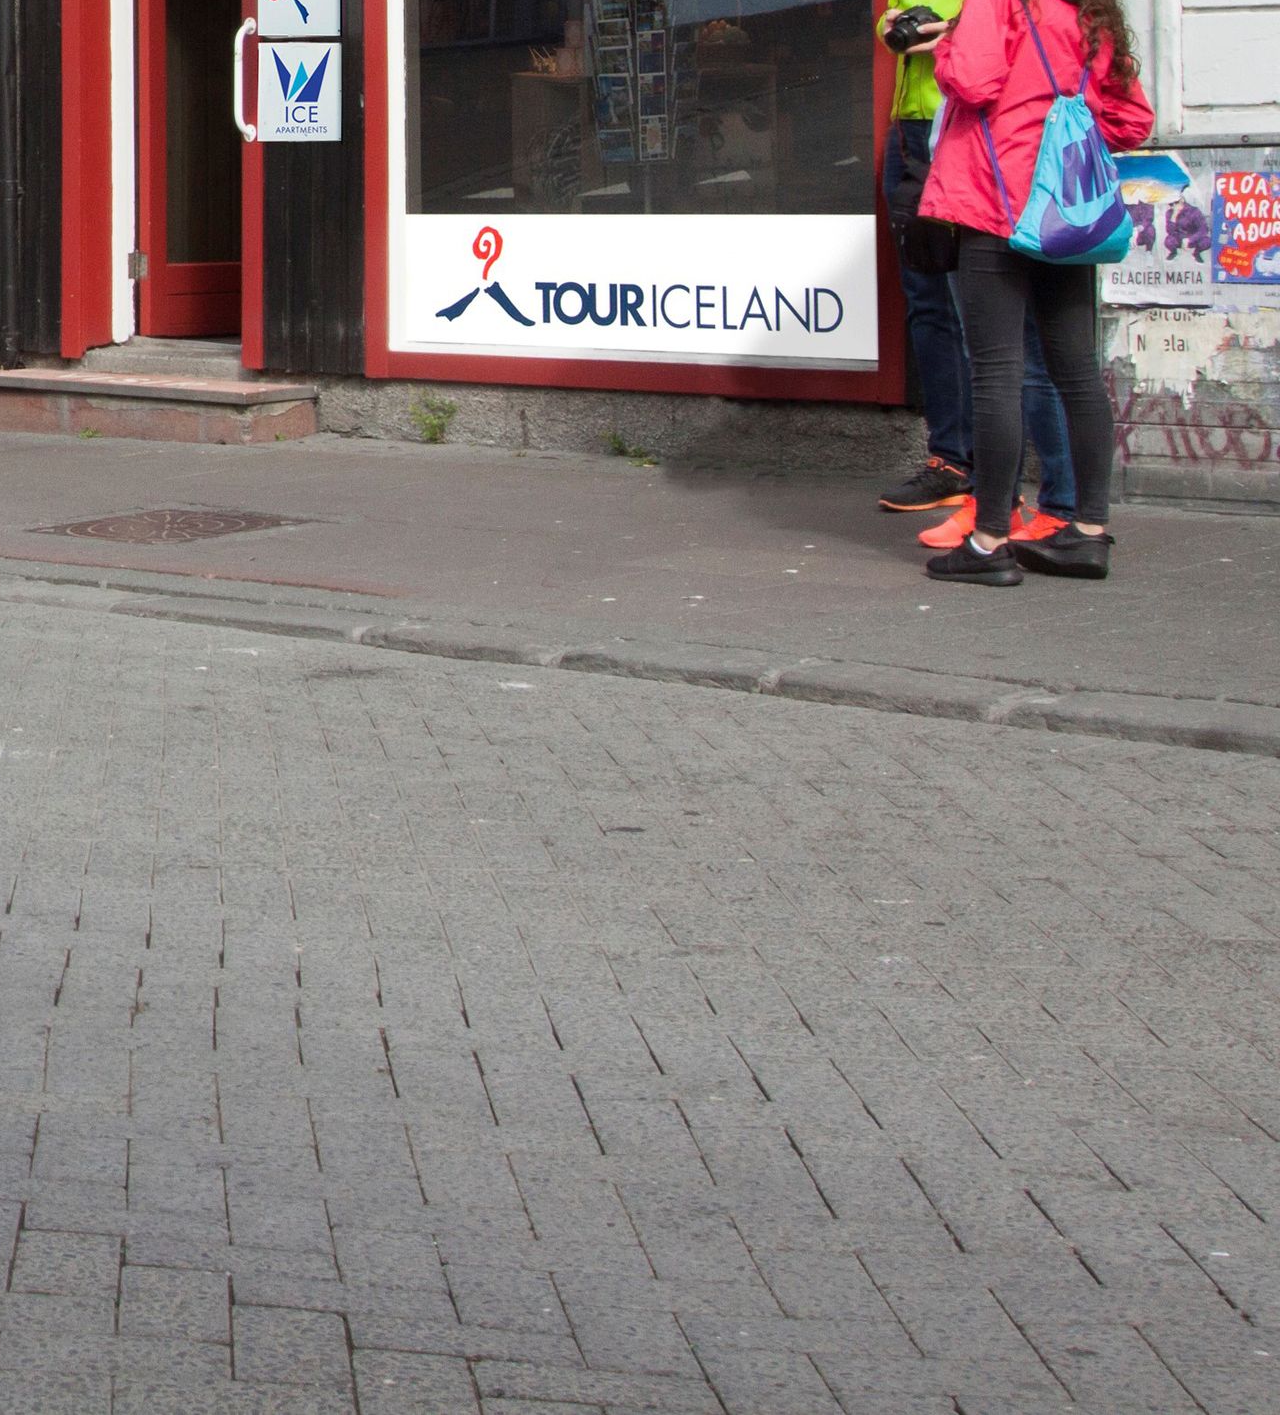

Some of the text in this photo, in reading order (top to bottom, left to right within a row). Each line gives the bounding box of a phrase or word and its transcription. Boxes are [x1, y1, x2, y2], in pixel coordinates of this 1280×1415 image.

[285, 106, 318, 123] ICE
[275, 126, 328, 134] APARTMENTS
[1216, 173, 1268, 196] FLÓA
[1111, 271, 1203, 285] GLACIER MAFIA
